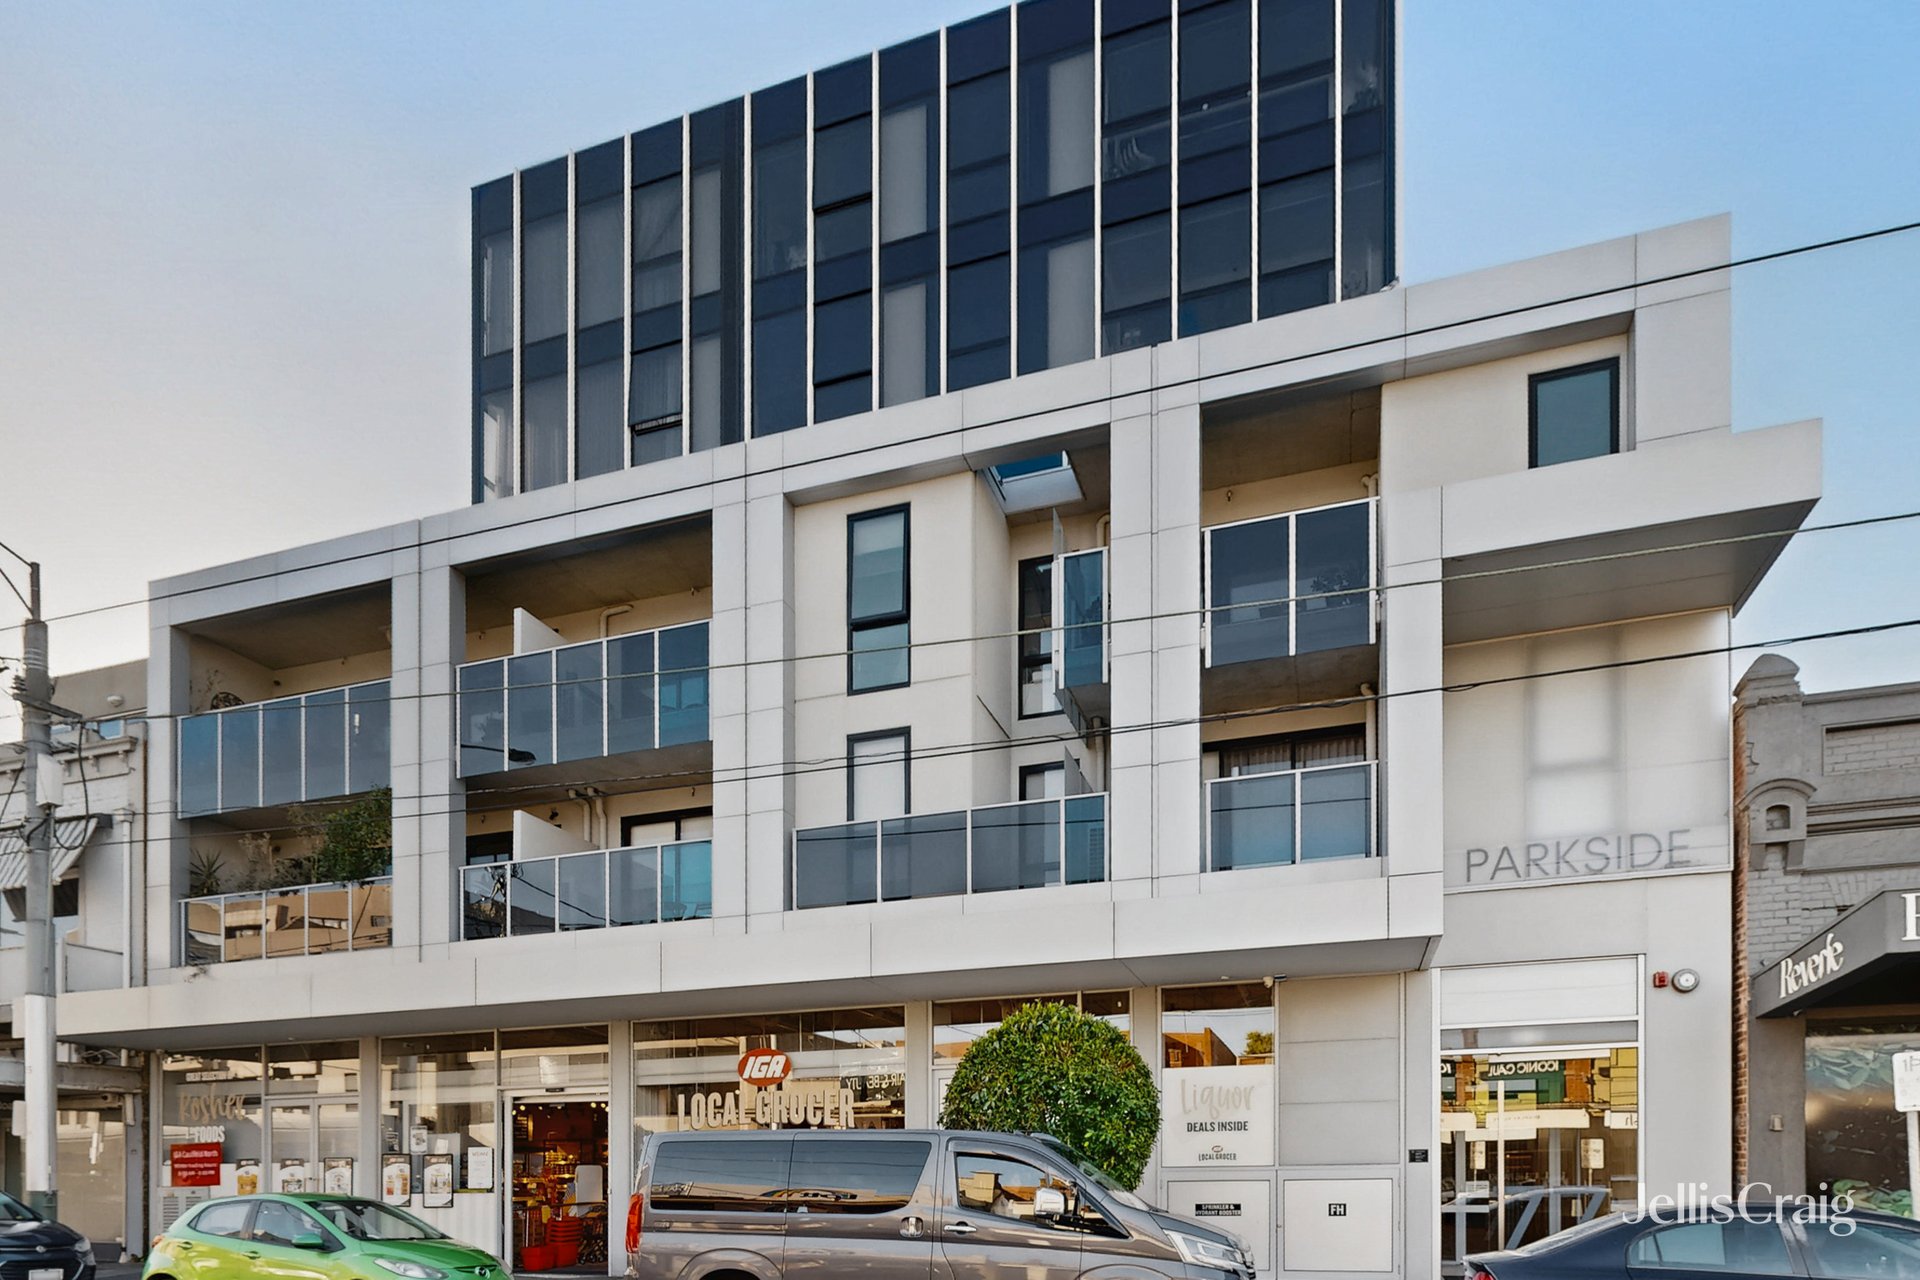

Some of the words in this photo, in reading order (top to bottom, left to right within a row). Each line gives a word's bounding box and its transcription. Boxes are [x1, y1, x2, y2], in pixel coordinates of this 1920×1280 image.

[1466, 829, 1692, 883] PARKSIDE
[743, 1055, 785, 1079] IGA
[179, 1083, 246, 1125] Kosher
[678, 1090, 752, 1132] LOCAL
[755, 1088, 855, 1129] GROCER
[1181, 1080, 1255, 1120] Liquor
[195, 1125, 226, 1143] FOODS
[1187, 1121, 1216, 1132] DEALS
[1217, 1120, 1249, 1131] INSIDE
[1198, 1153, 1214, 1162] LOCAL
[1215, 1152, 1238, 1160] GROCER
[1330, 1204, 1345, 1216] FH
